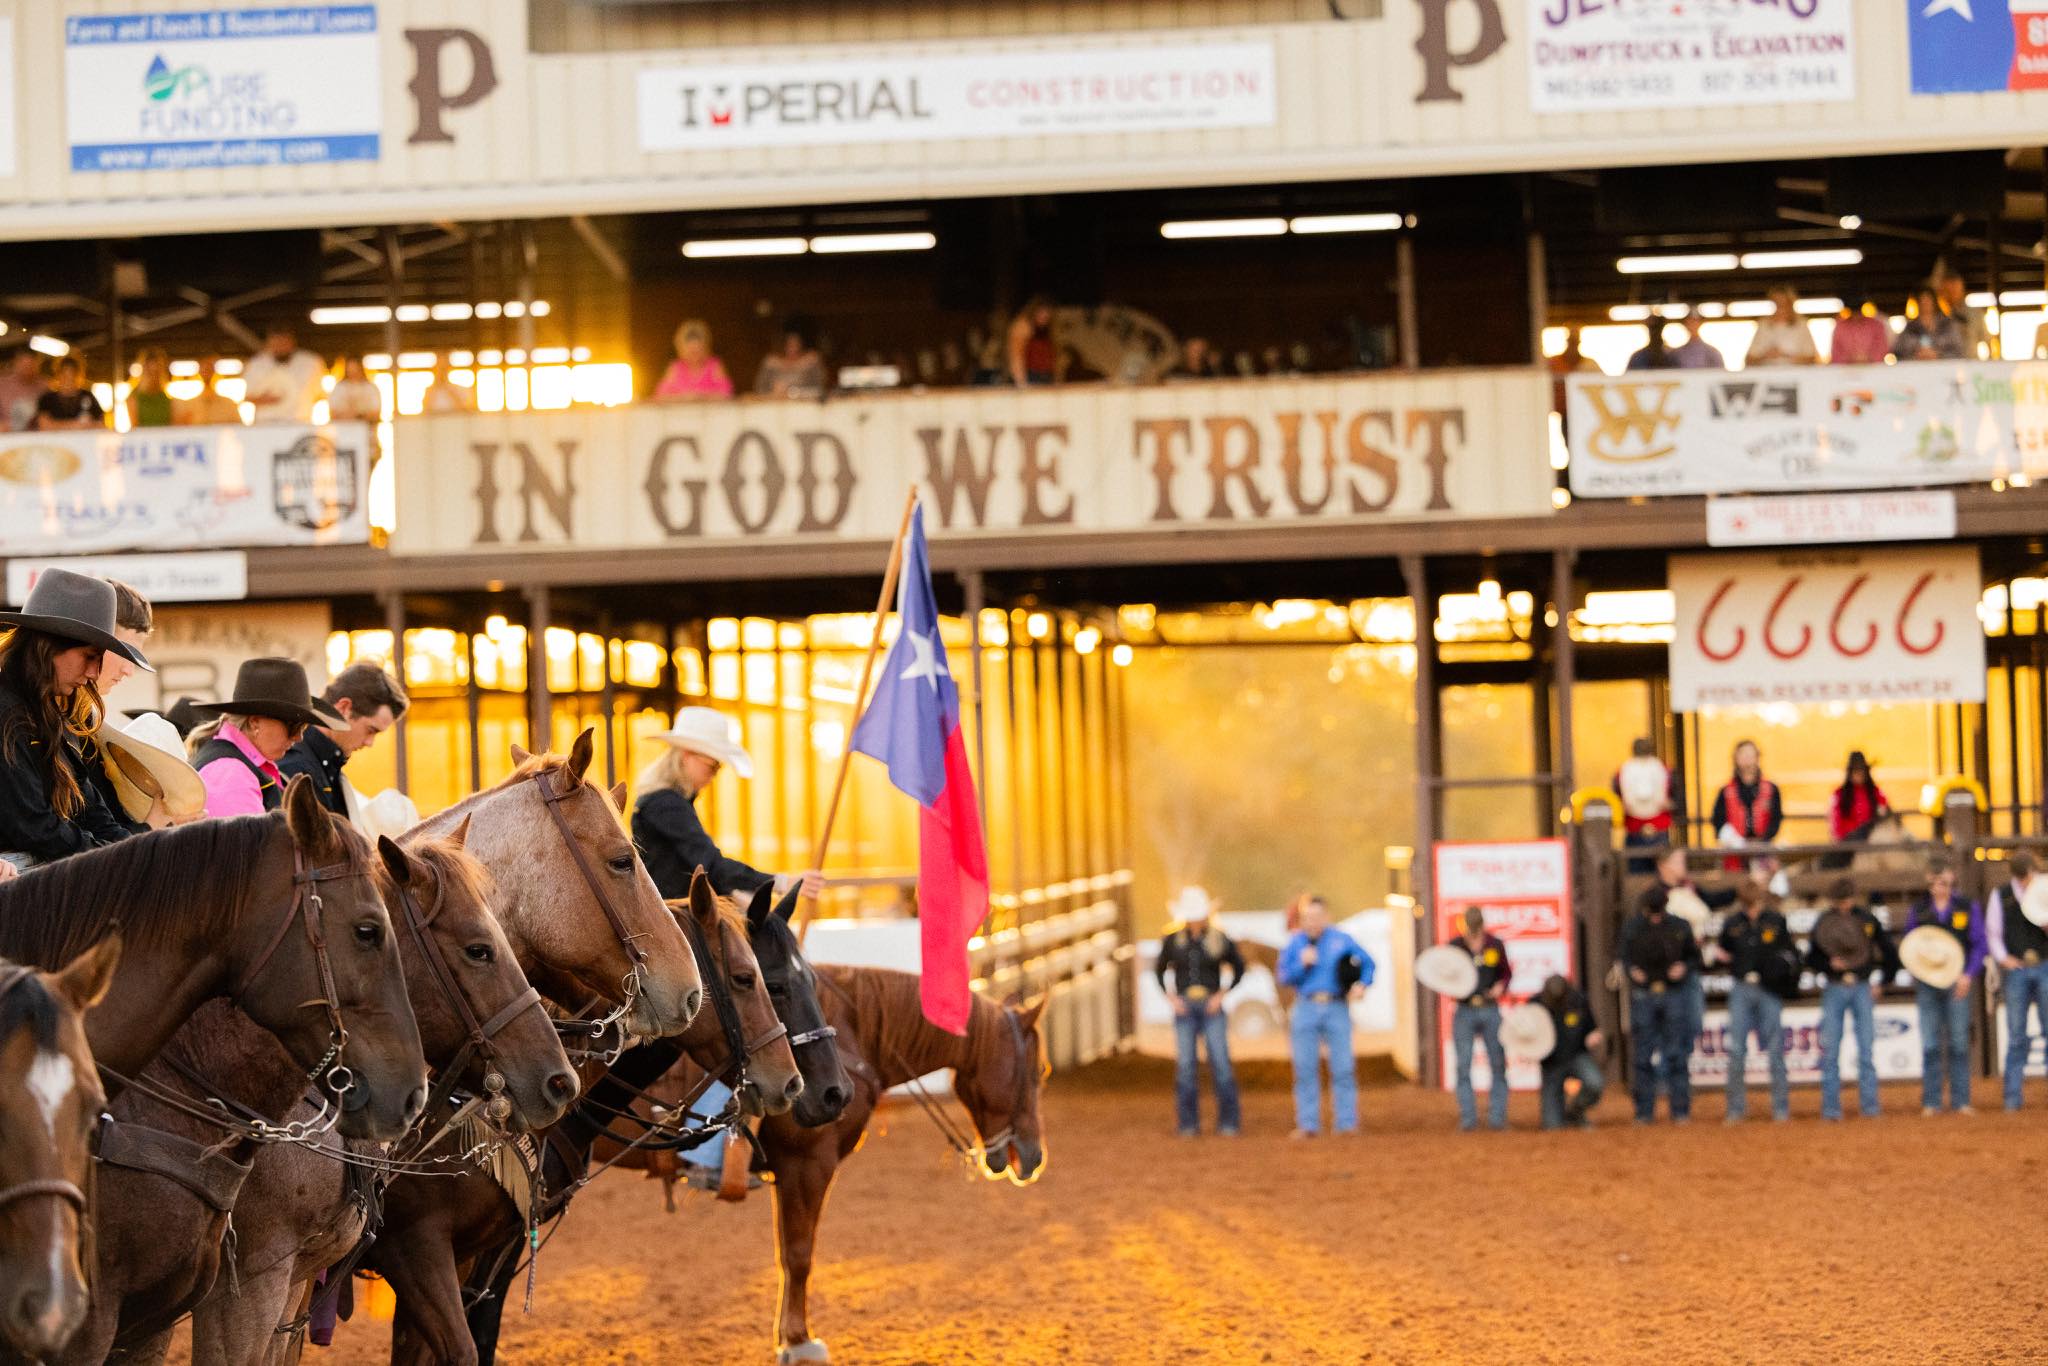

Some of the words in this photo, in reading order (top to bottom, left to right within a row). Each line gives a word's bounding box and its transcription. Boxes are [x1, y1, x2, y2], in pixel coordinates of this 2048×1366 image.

[403, 28, 497, 144] P
[966, 70, 1260, 108] CONSTRUCTION
[1415, 0, 1507, 104] P
[139, 101, 298, 134] FUNDING
[470, 441, 580, 543] IN
[645, 429, 858, 537] GOD
[915, 425, 1076, 528] WE
[1133, 408, 1467, 521] TRUST
